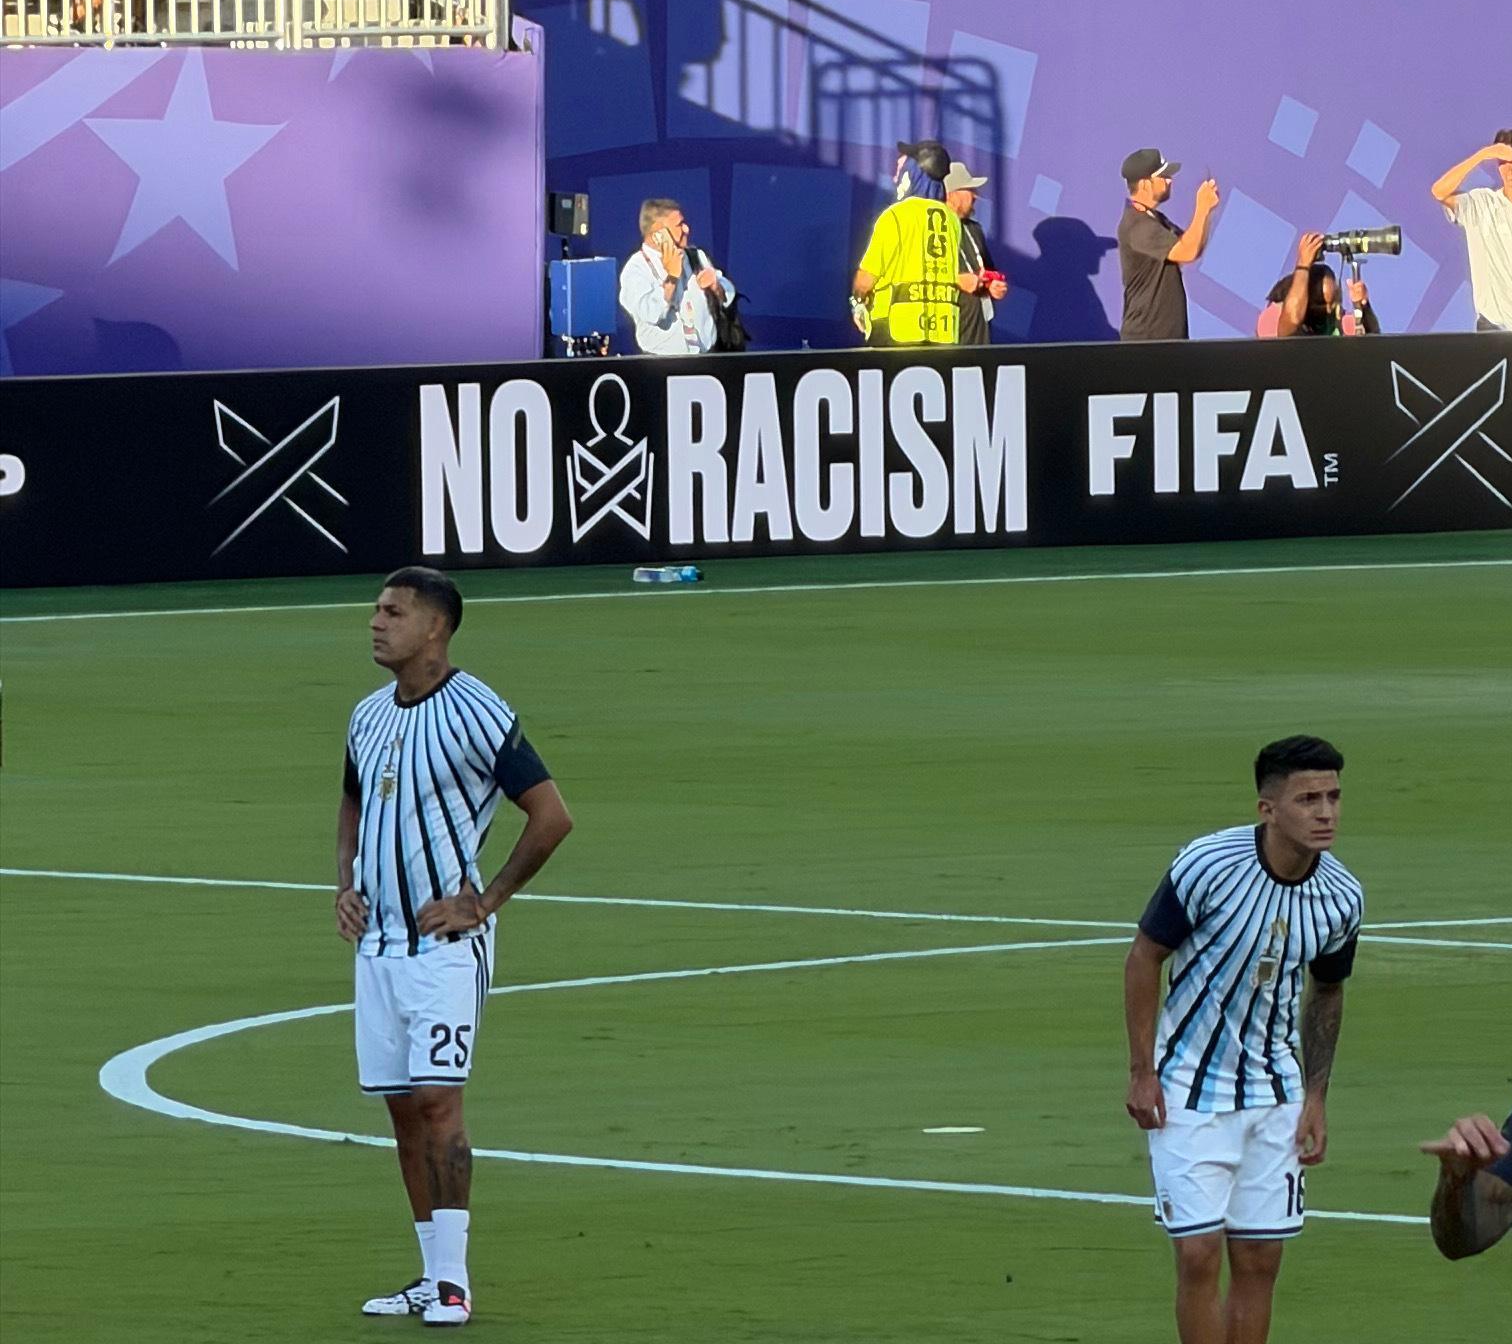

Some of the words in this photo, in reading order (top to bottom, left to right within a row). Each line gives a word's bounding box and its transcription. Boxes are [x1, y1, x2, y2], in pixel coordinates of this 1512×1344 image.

[419, 378, 554, 556] NO
[666, 364, 1028, 545] RACISM
[1088, 389, 1318, 496] FIFA
[431, 1023, 471, 1067] 25
